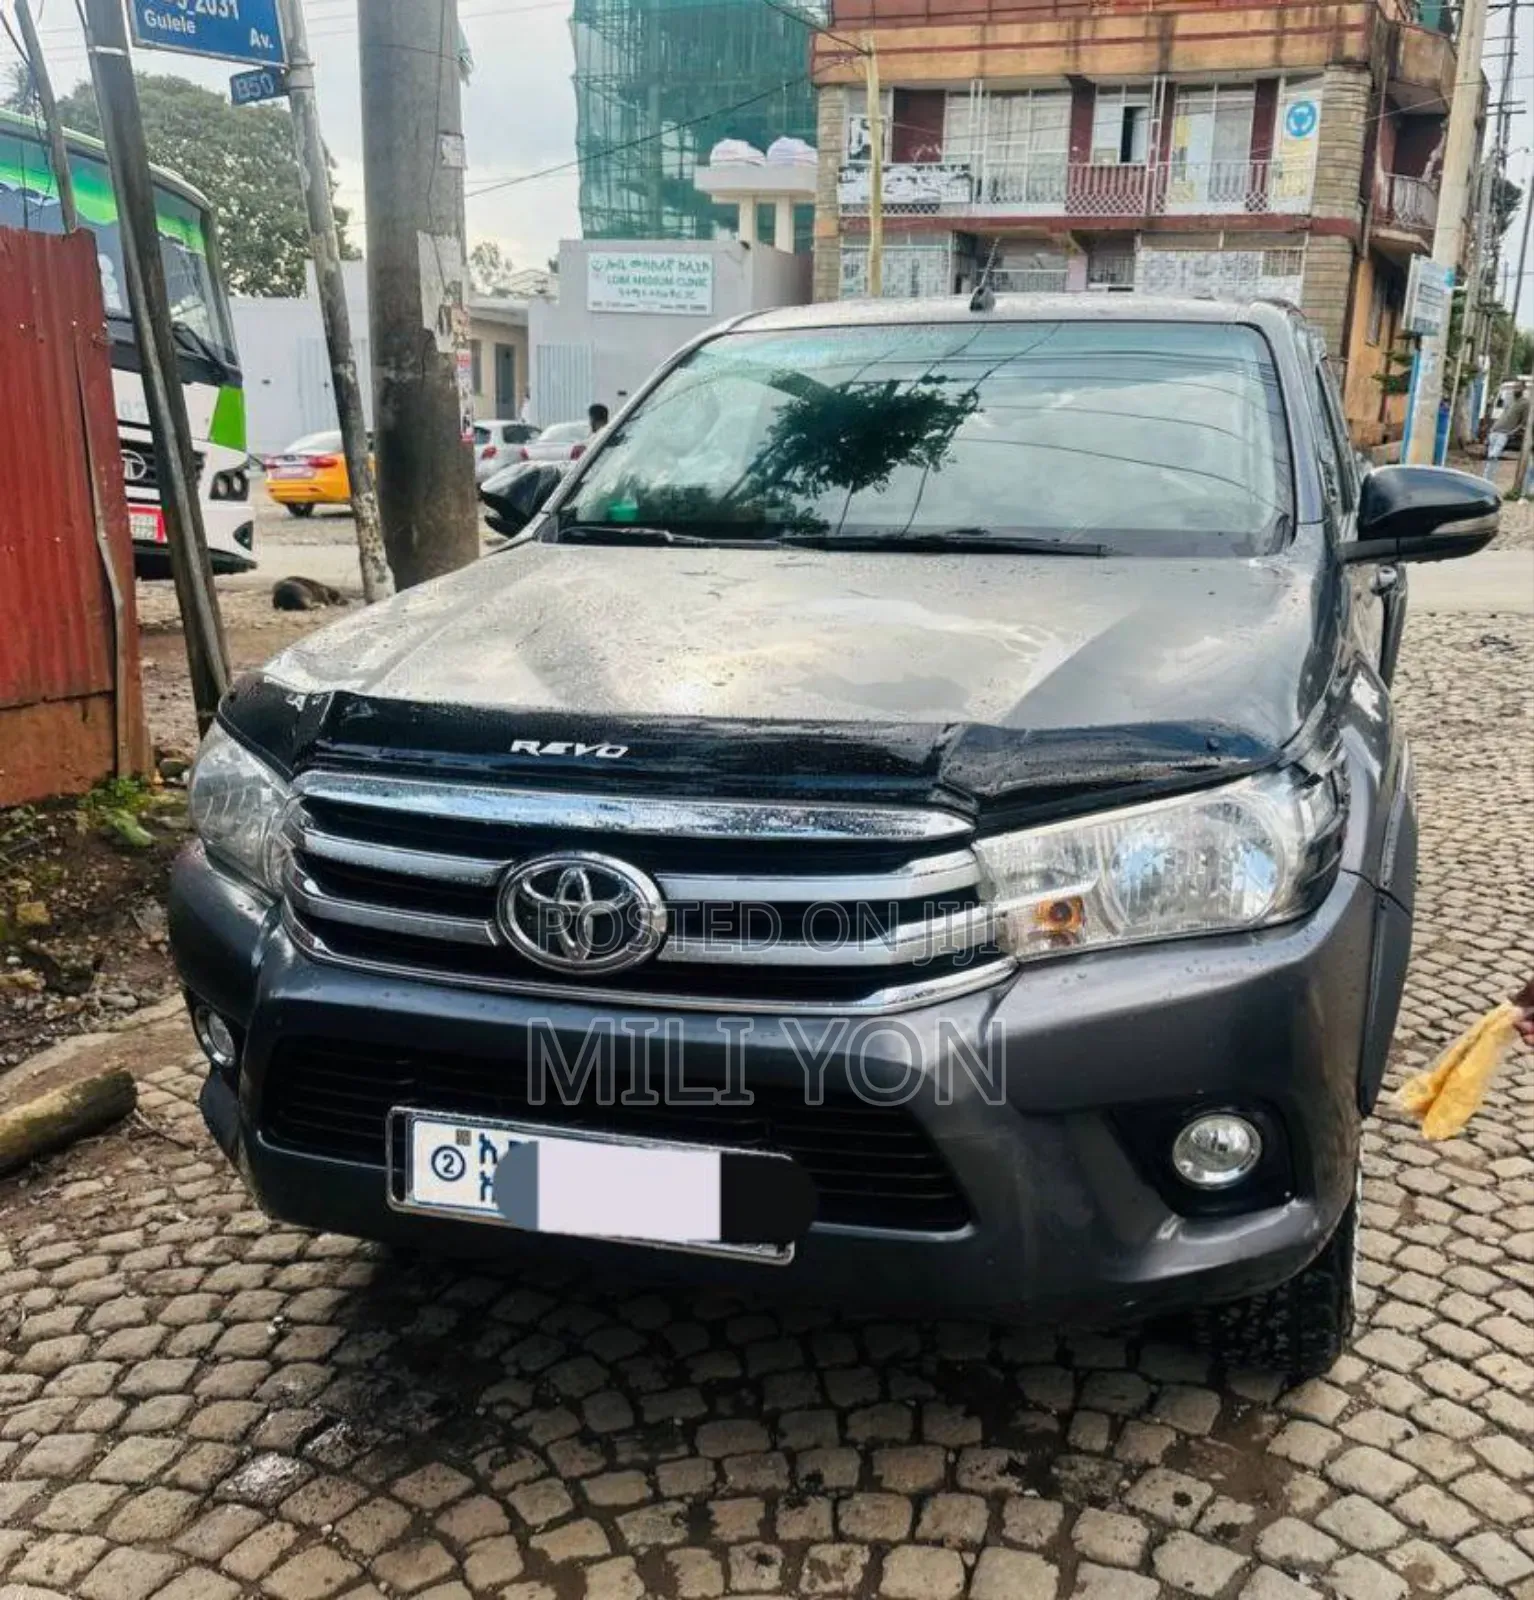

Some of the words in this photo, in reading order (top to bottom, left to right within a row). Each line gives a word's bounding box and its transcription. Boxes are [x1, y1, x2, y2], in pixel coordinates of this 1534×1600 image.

[144, 10, 196, 34] Gulele
[250, 27, 274, 49] Av.
[677, 277, 708, 287] CLINIC
[510, 740, 628, 758] REVO
